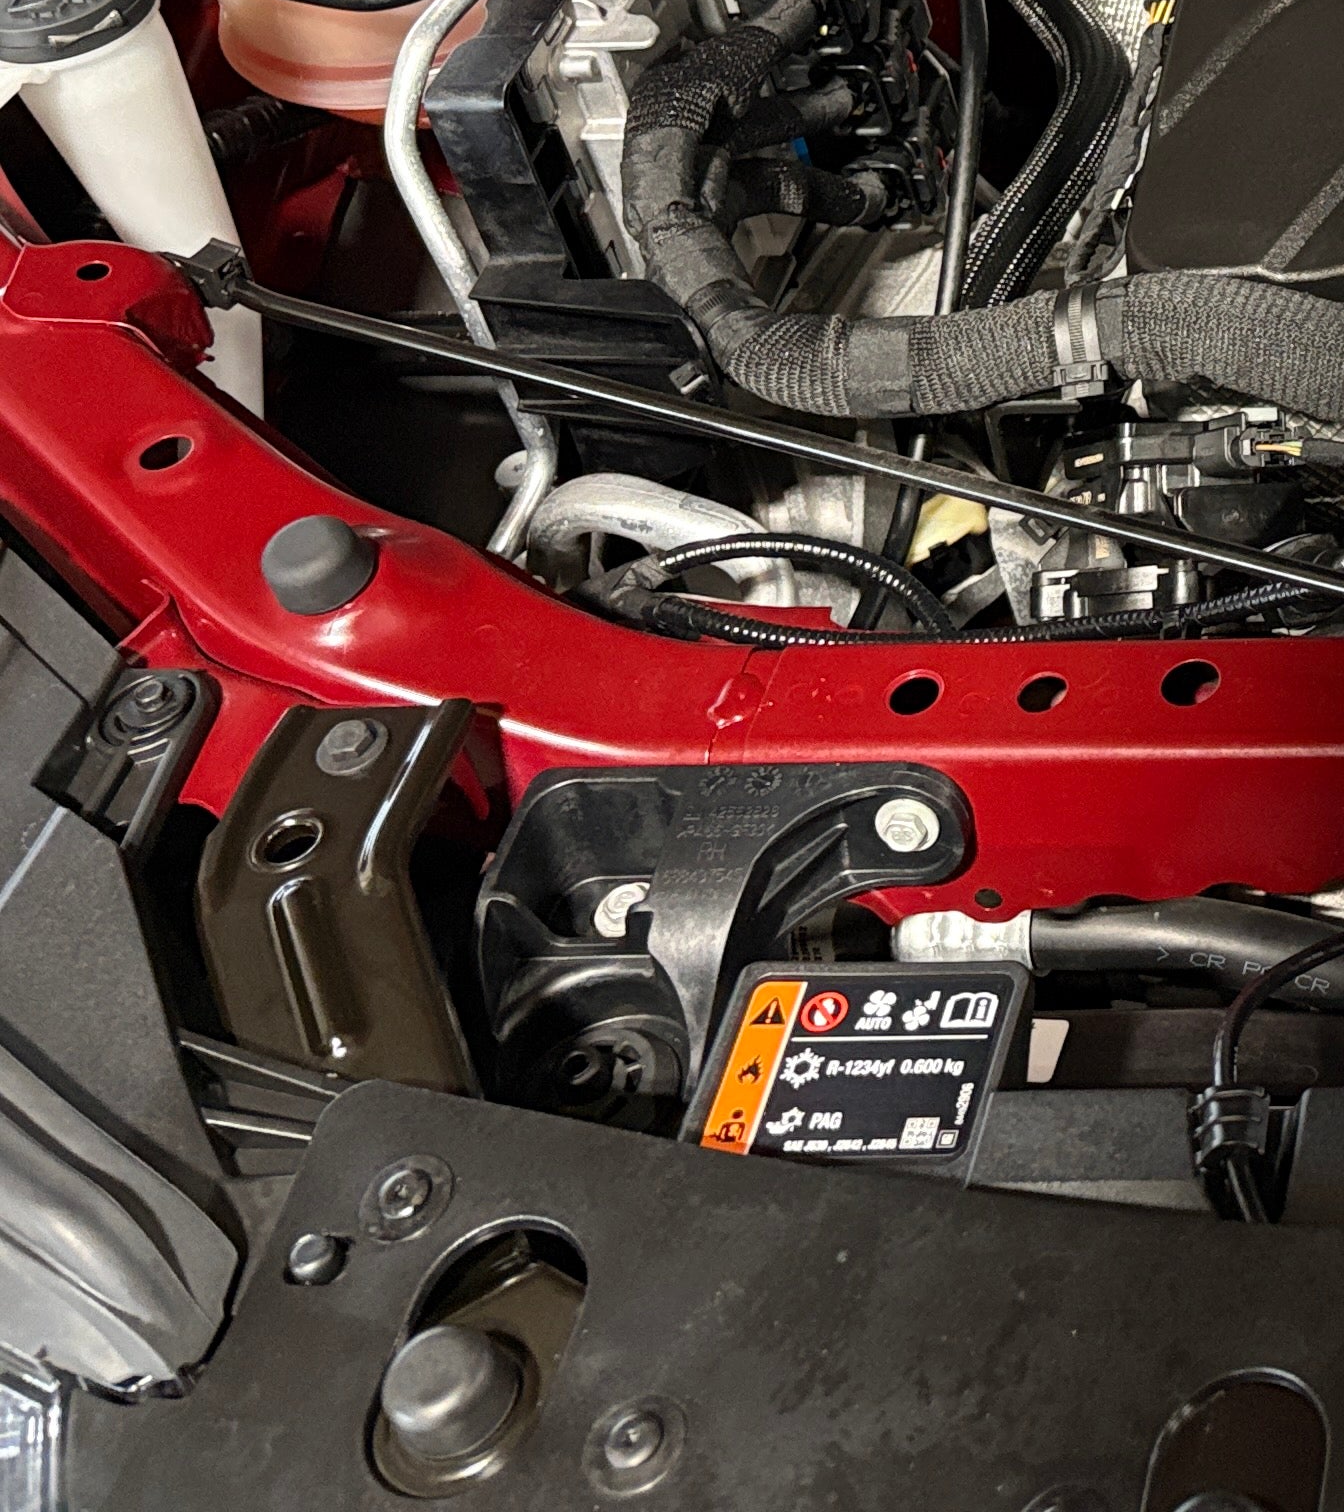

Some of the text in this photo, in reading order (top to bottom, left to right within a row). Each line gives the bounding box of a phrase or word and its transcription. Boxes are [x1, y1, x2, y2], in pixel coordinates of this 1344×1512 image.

[1189, 951, 1227, 970] CR
[1294, 974, 1330, 995] CR
[854, 1016, 892, 1031] AUTO
[825, 1058, 965, 1077] R-1234yf 0.600 kg
[808, 1111, 843, 1130] PAG
